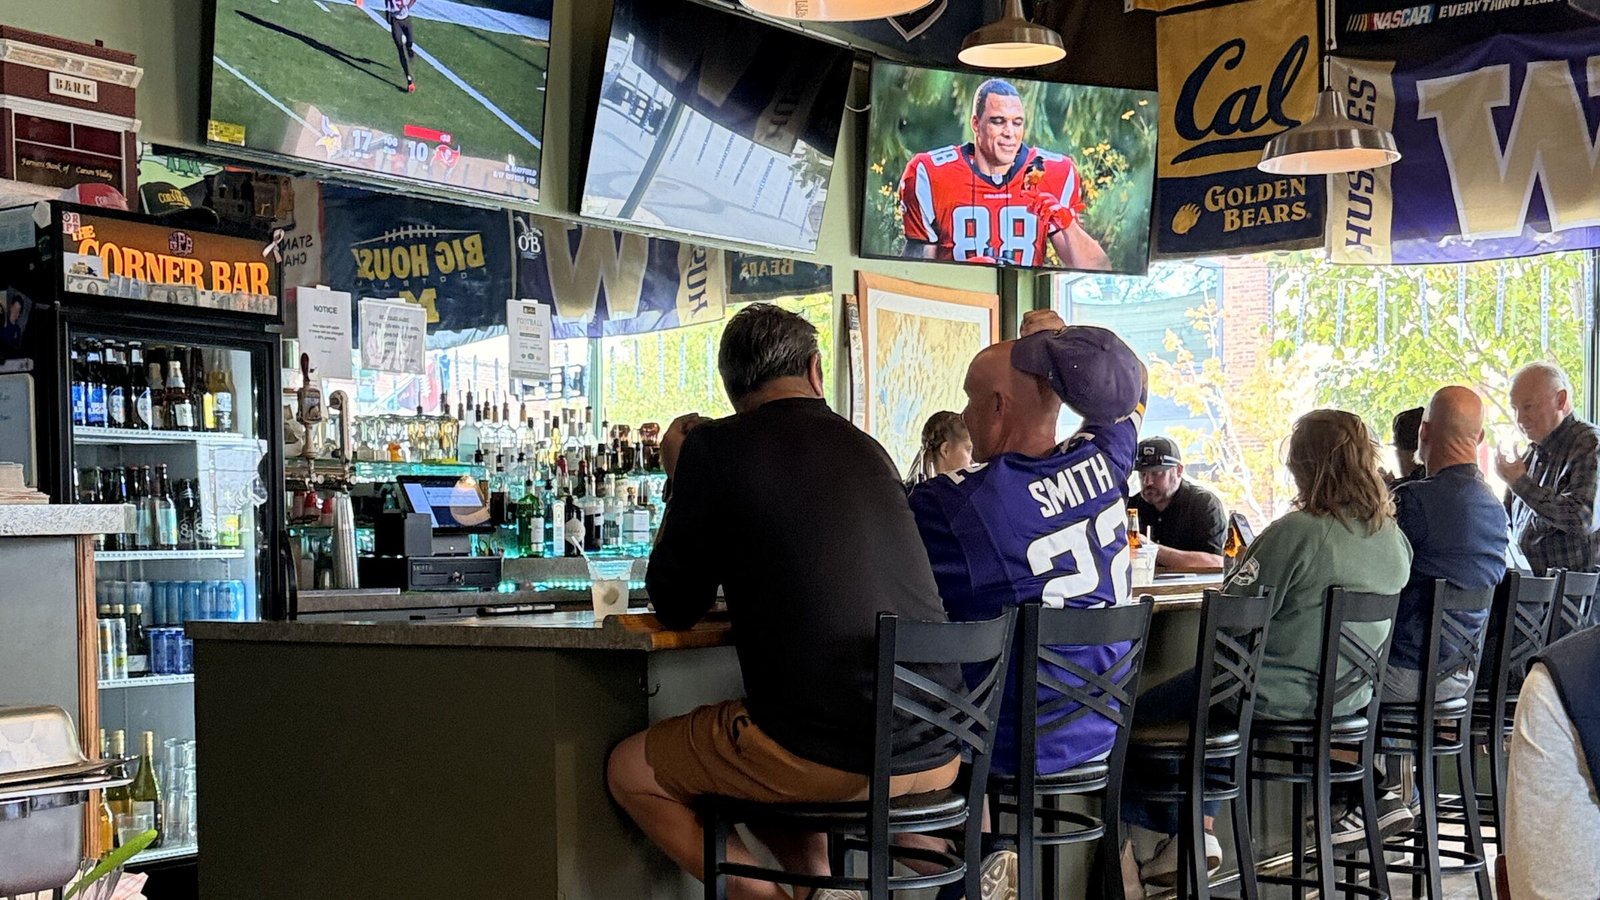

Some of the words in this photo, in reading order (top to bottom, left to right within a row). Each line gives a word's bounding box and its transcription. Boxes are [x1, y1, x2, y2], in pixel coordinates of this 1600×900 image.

[1373, 5, 1432, 31] NASCAR
[55, 78, 92, 96] BANK
[1174, 35, 1310, 141] Cal
[353, 129, 372, 151] 17
[408, 140, 429, 162] 10
[1416, 59, 1600, 241] W
[1345, 76, 1377, 255] HUSES
[1204, 177, 1308, 212] GOLDEN
[72, 224, 96, 242] THE
[1222, 201, 1308, 233] BEARS
[953, 206, 1037, 266] 88
[210, 261, 269, 296] BAR
[313, 304, 338, 315] NOTICE
[1028, 453, 1114, 518] SMITH
[1026, 498, 1132, 609] 22
